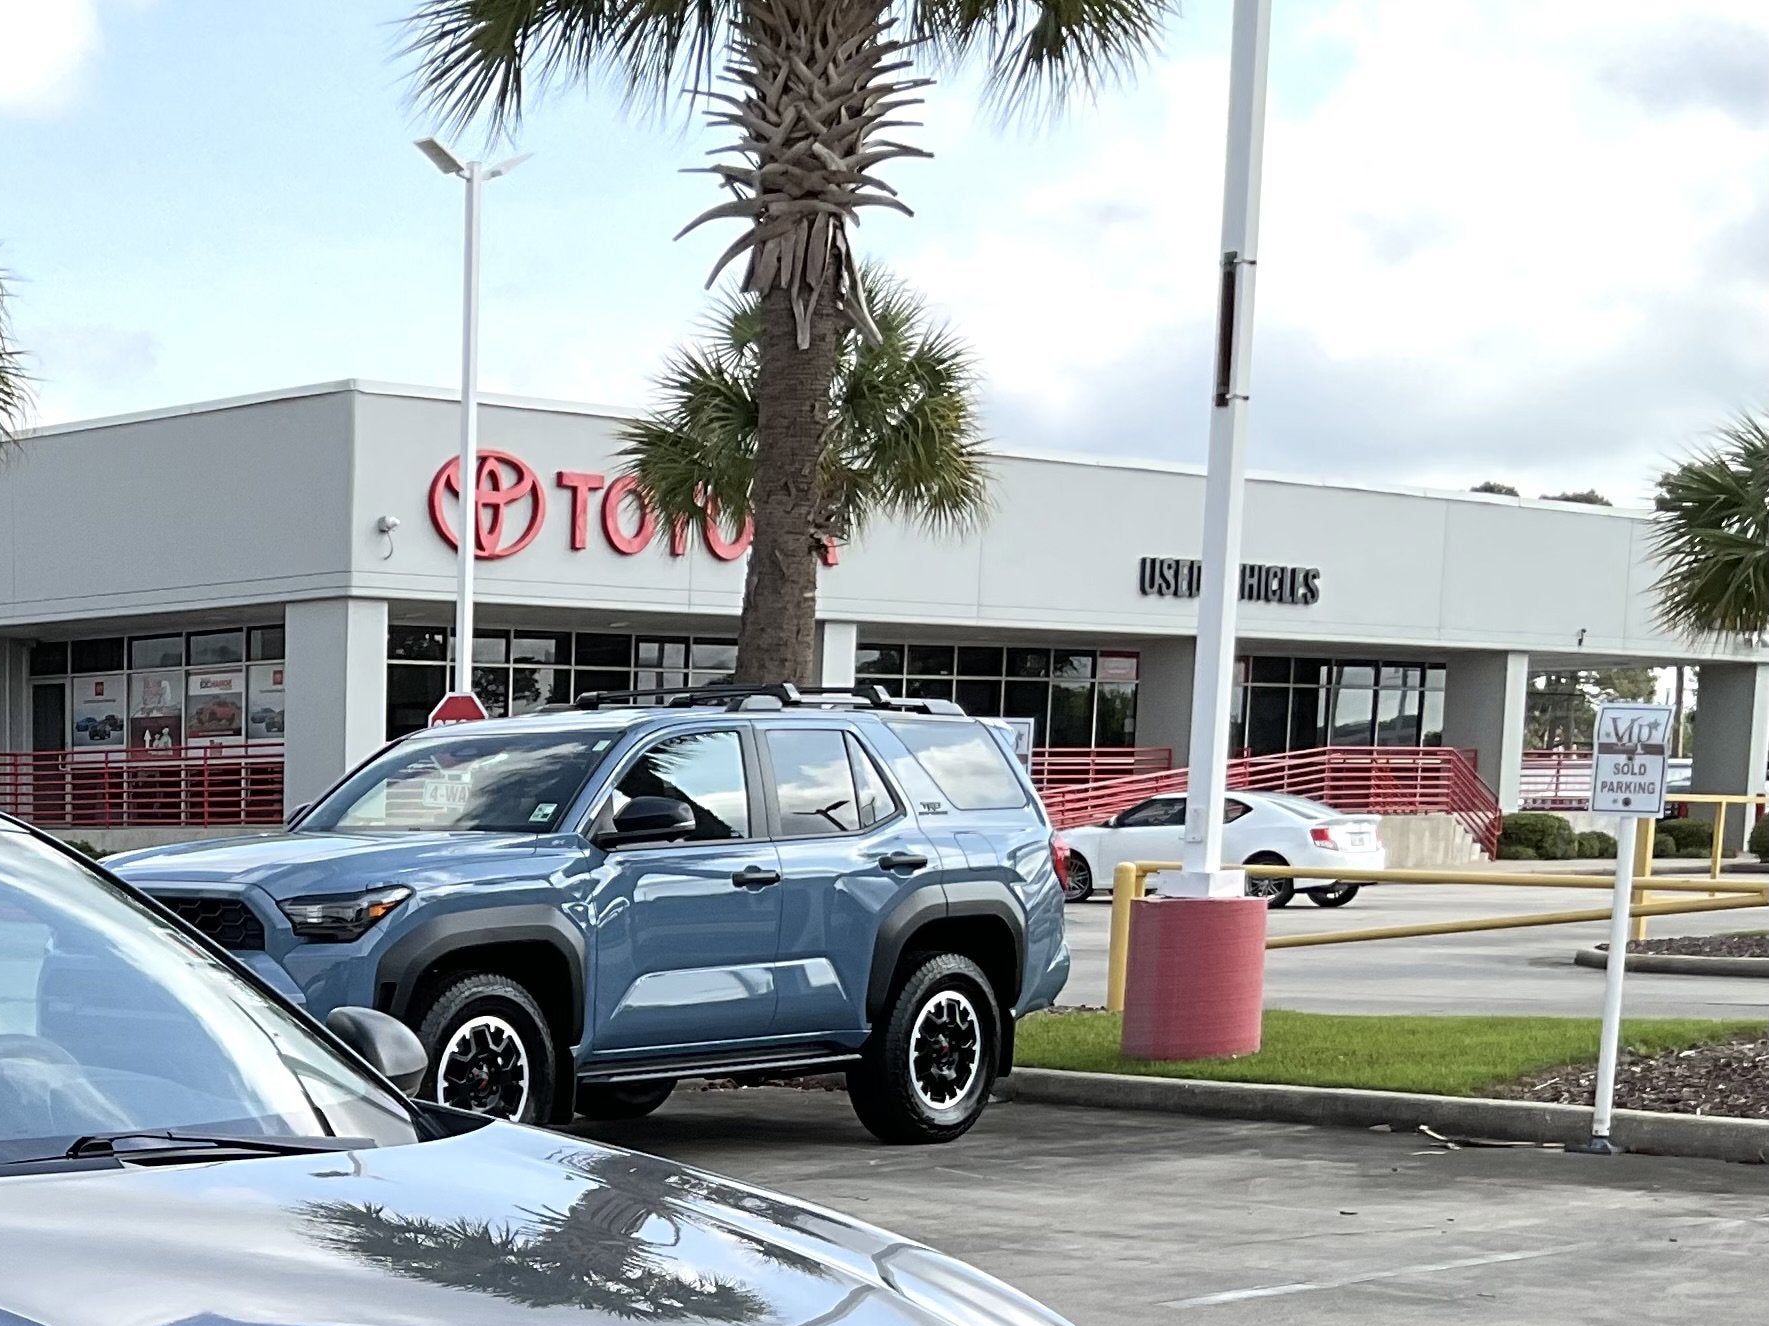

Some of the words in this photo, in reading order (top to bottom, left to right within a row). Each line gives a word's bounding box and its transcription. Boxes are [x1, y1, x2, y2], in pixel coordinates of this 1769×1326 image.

[1238, 563, 1321, 605] HICLES
[1613, 763, 1647, 776] SOLD
[1601, 781, 1656, 795] PARKING
